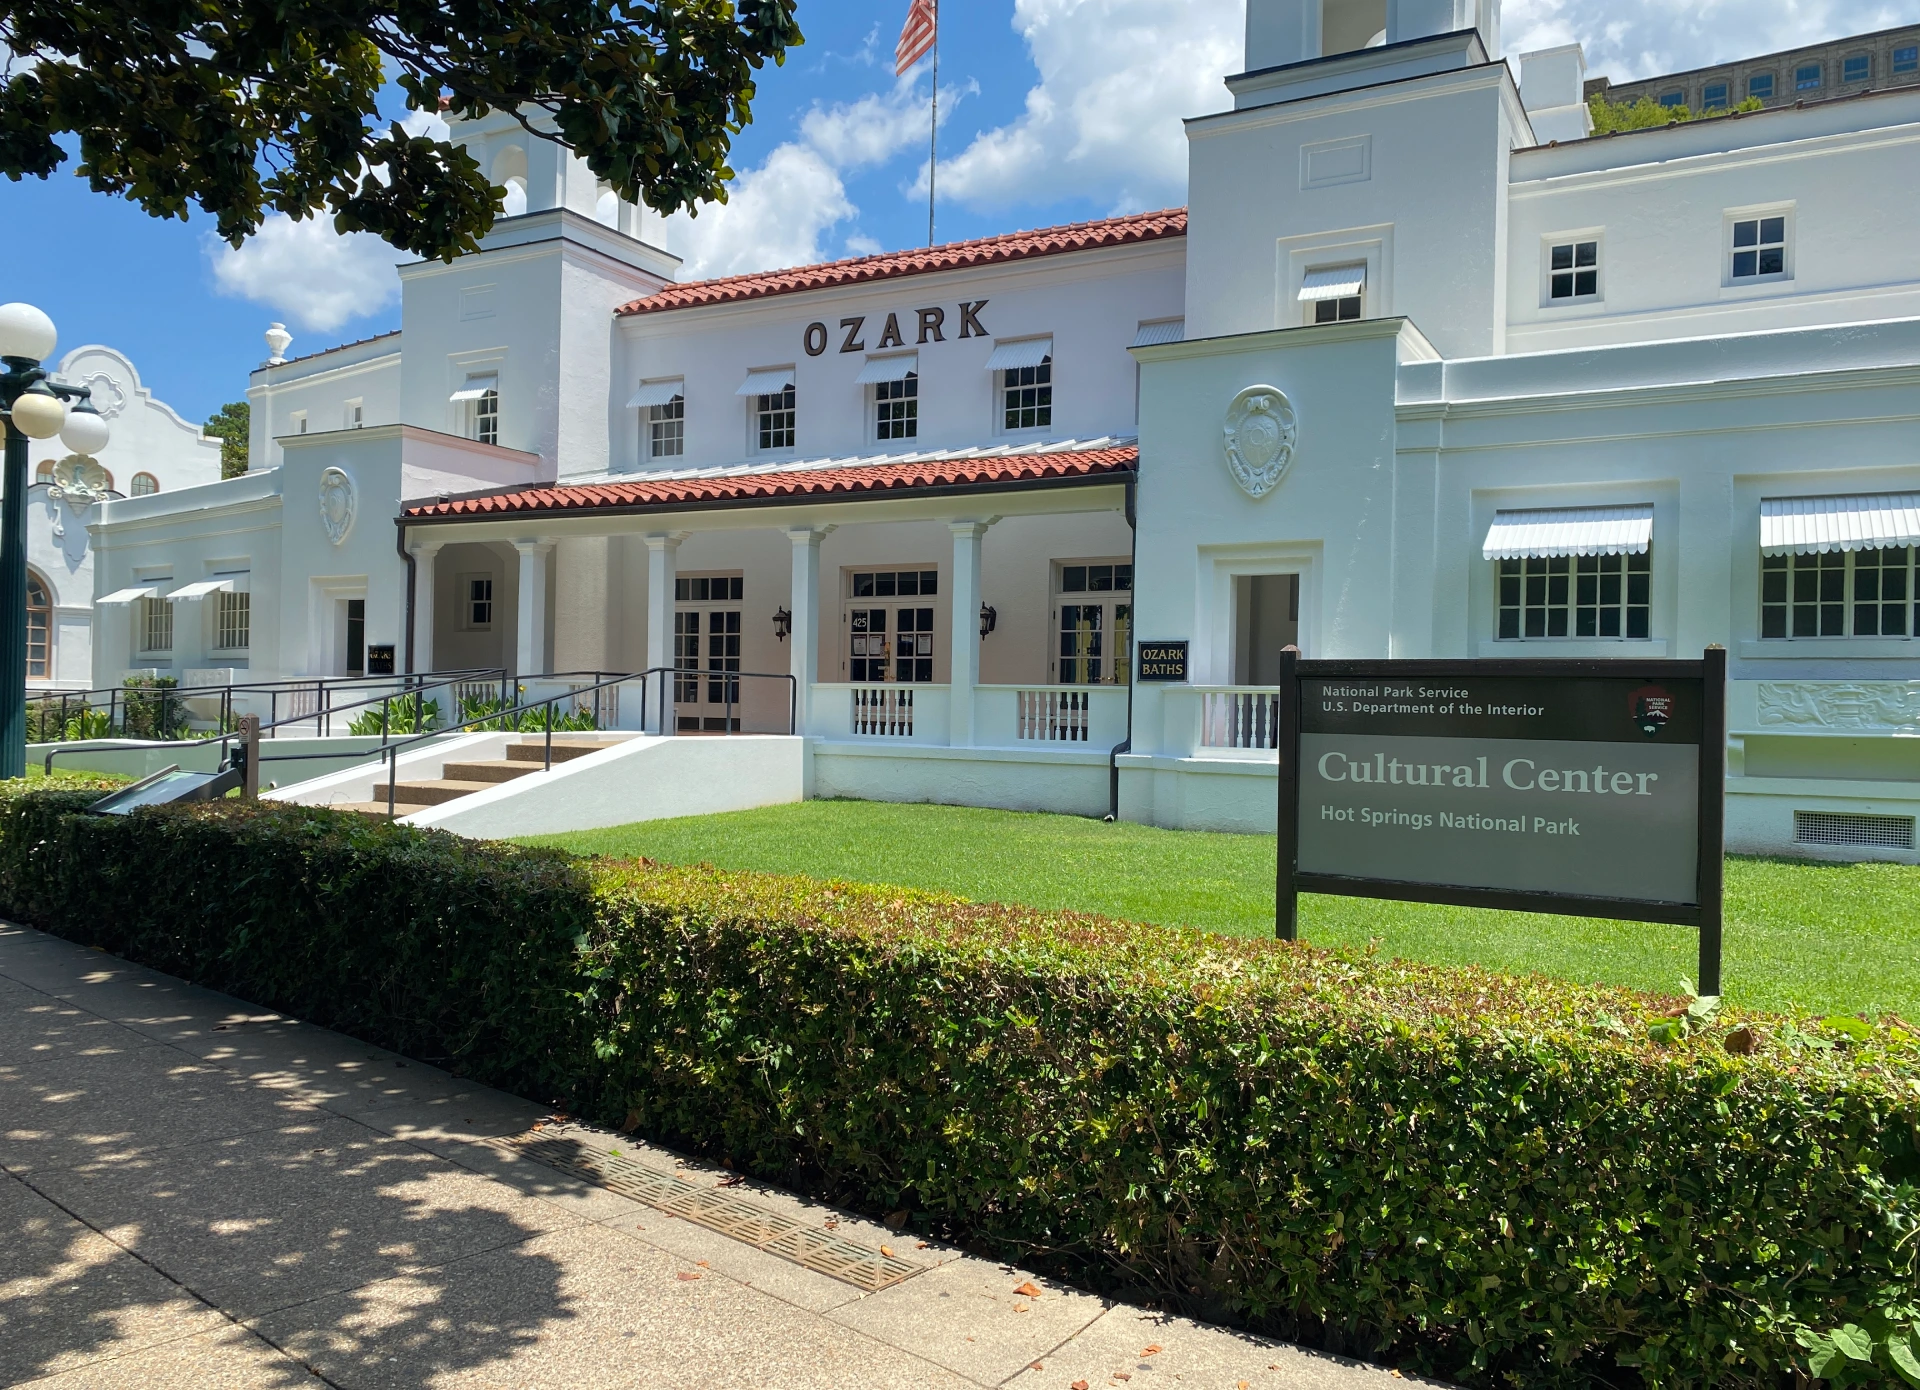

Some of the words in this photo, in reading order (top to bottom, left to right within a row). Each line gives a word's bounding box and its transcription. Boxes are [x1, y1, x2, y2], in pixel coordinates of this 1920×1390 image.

[803, 299, 990, 357] OZARK
[852, 617, 867, 628] 425
[1142, 649, 1184, 659] OZARK
[1142, 664, 1183, 675] BATHS
[1322, 685, 1379, 697] National
[1383, 686, 1414, 698] Park
[1418, 686, 1469, 699] Service
[1322, 701, 1348, 712] U.S.
[1353, 701, 1435, 715] Department
[1439, 702, 1455, 714] of
[1459, 703, 1483, 715] the
[1487, 703, 1545, 716] Interior
[1317, 751, 1490, 788] Cultural
[1502, 758, 1659, 796] Center
[1321, 804, 1355, 822] Hot
[1360, 807, 1433, 831] Springs
[1439, 811, 1526, 832] National
[1533, 817, 1581, 836] Park
